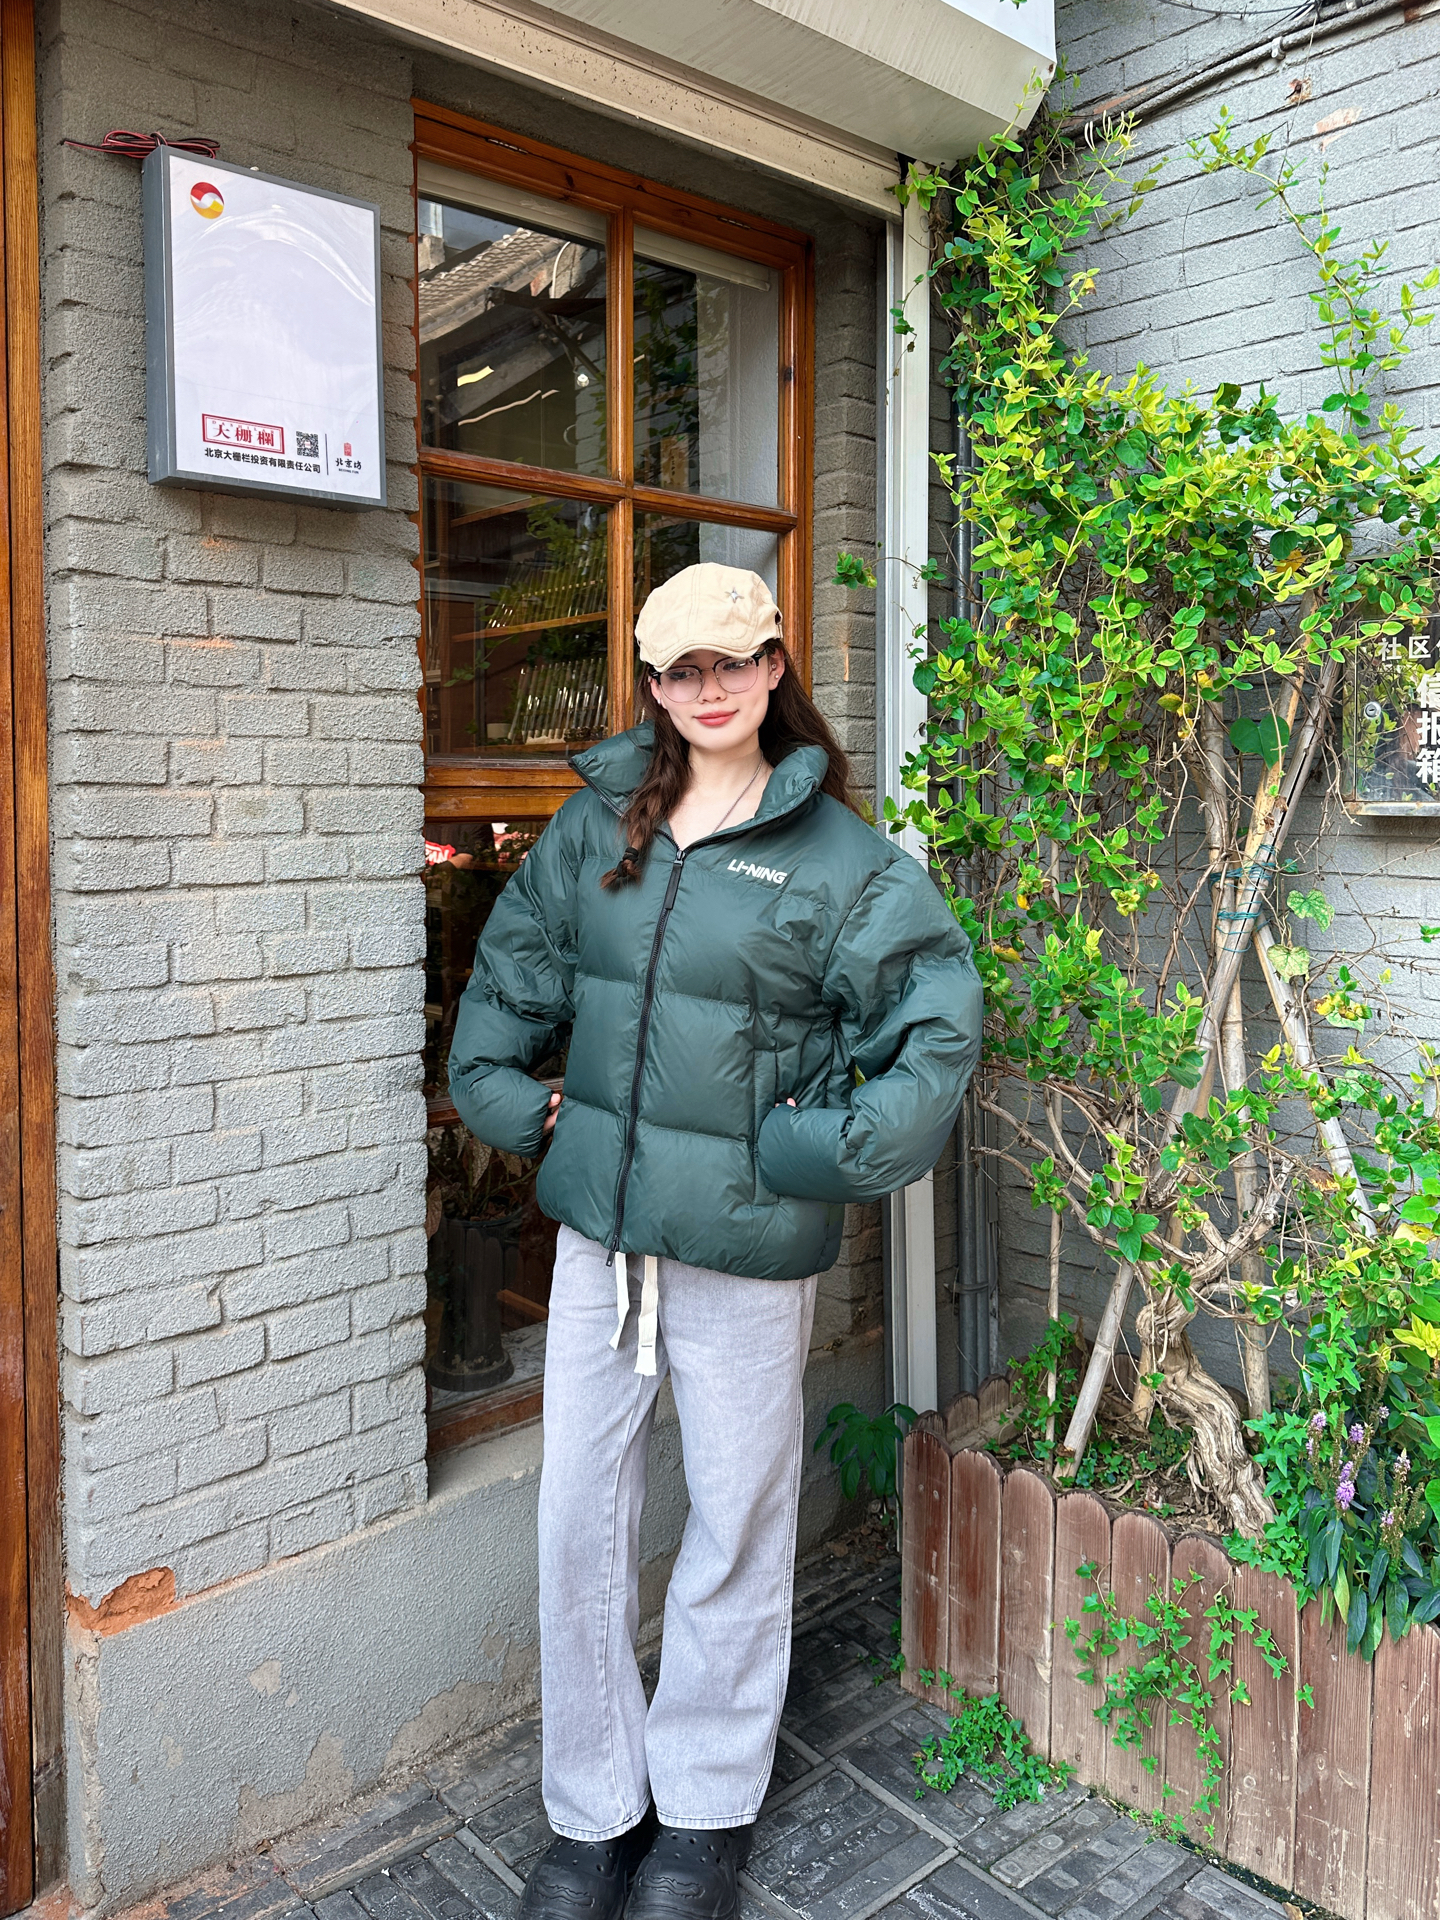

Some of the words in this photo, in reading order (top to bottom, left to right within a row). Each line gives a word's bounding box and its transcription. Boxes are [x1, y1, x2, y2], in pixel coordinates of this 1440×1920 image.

[205, 448, 320, 473] 北京大栅栏投资有限责任公司
[1378, 635, 1440, 661] 社区
[727, 859, 788, 884] LI-NING
